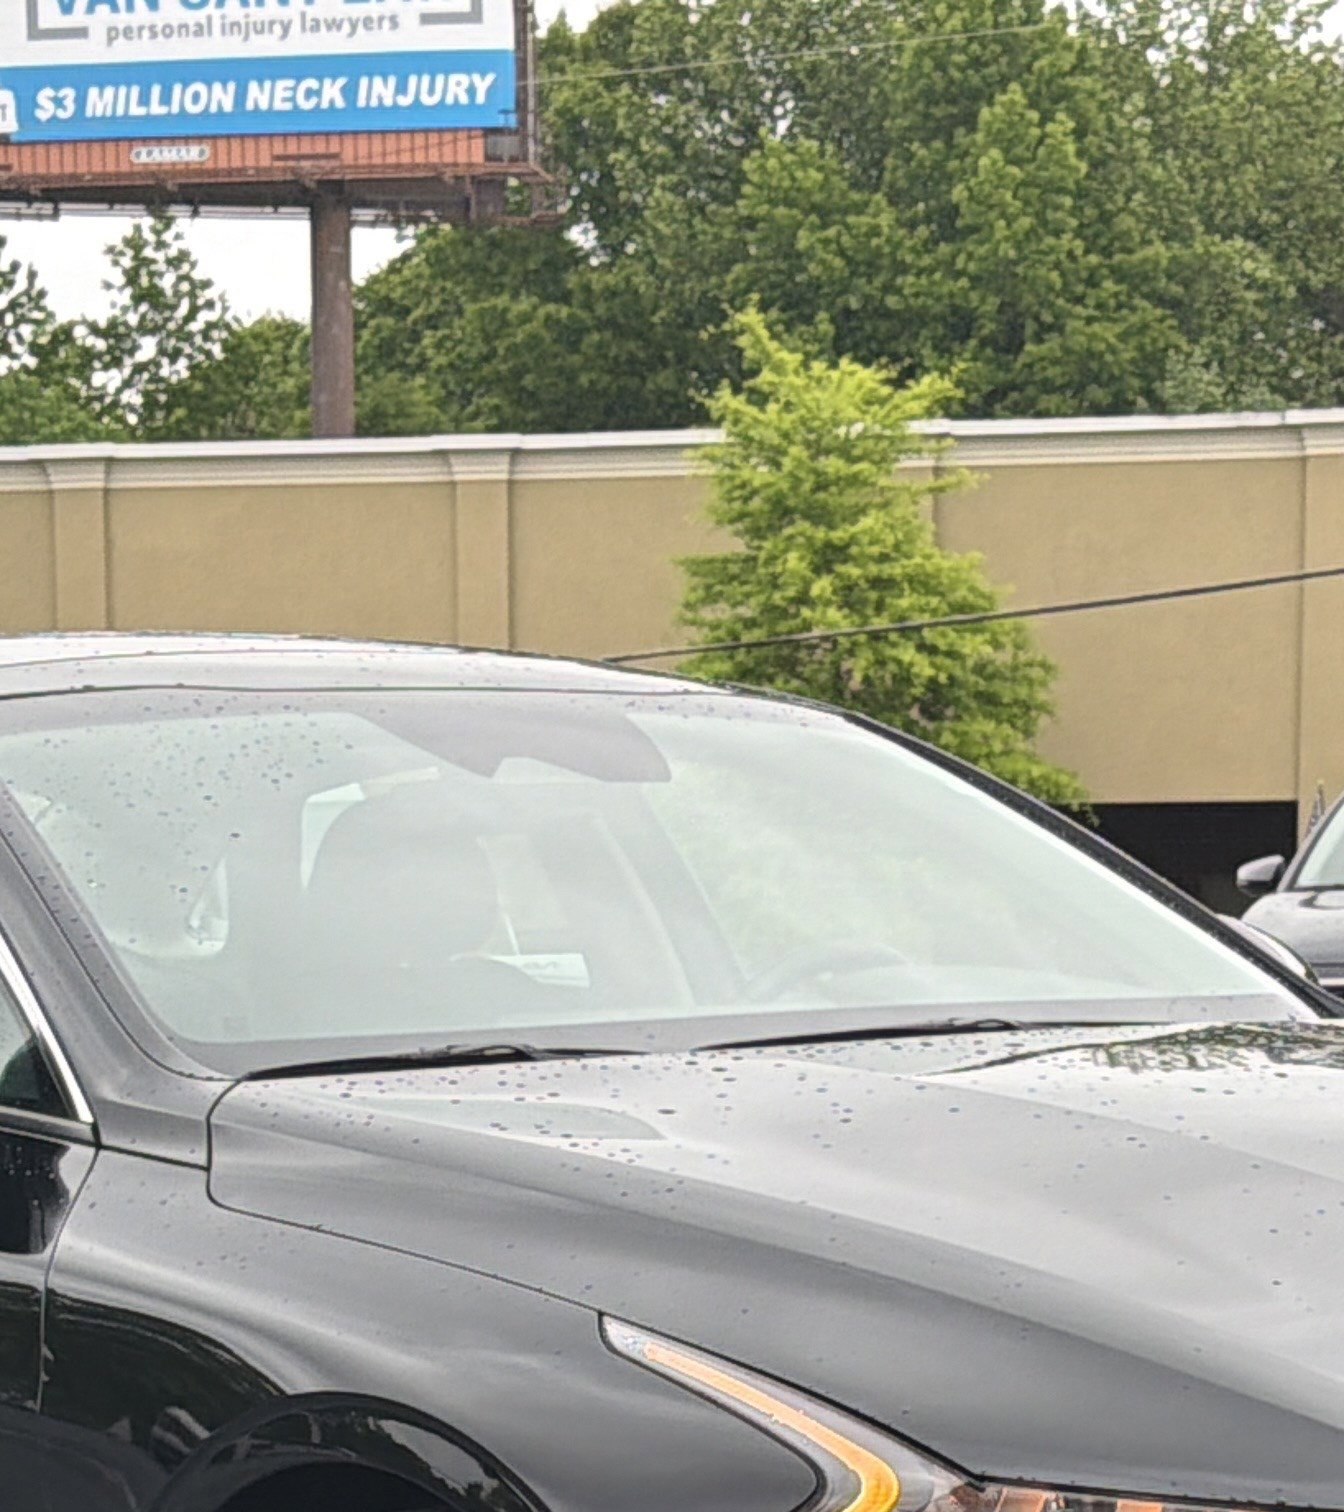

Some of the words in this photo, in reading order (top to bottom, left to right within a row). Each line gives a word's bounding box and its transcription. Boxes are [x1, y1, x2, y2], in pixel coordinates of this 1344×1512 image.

[106, 14, 213, 47] personal
[220, 14, 293, 43] injury
[300, 11, 400, 38] lawyers
[34, 86, 77, 122] $3
[85, 80, 236, 118] MILLION
[245, 76, 348, 111] NECK
[356, 71, 497, 108] INJURY
